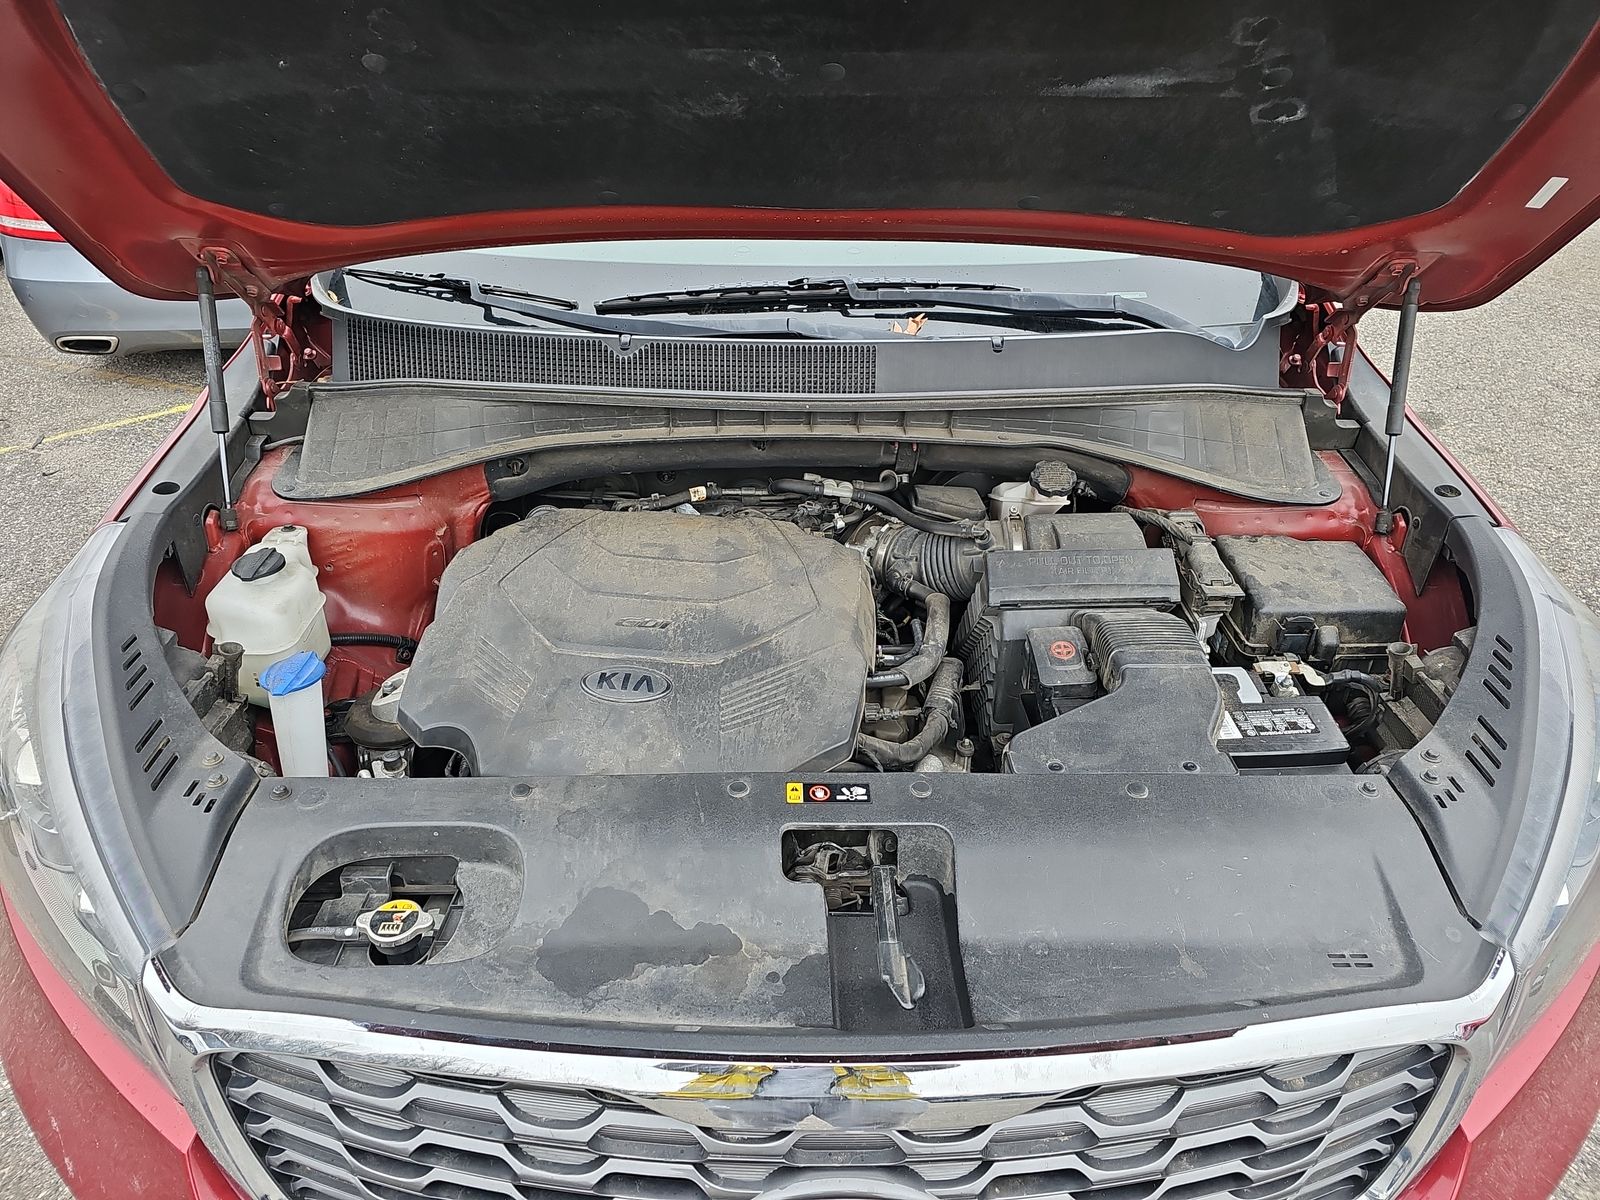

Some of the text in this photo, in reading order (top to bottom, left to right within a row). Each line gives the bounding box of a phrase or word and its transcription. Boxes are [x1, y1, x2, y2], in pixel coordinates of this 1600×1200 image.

[1028, 555, 1135, 566] PULL OUT TO OPEN
[596, 672, 655, 694] KIA
